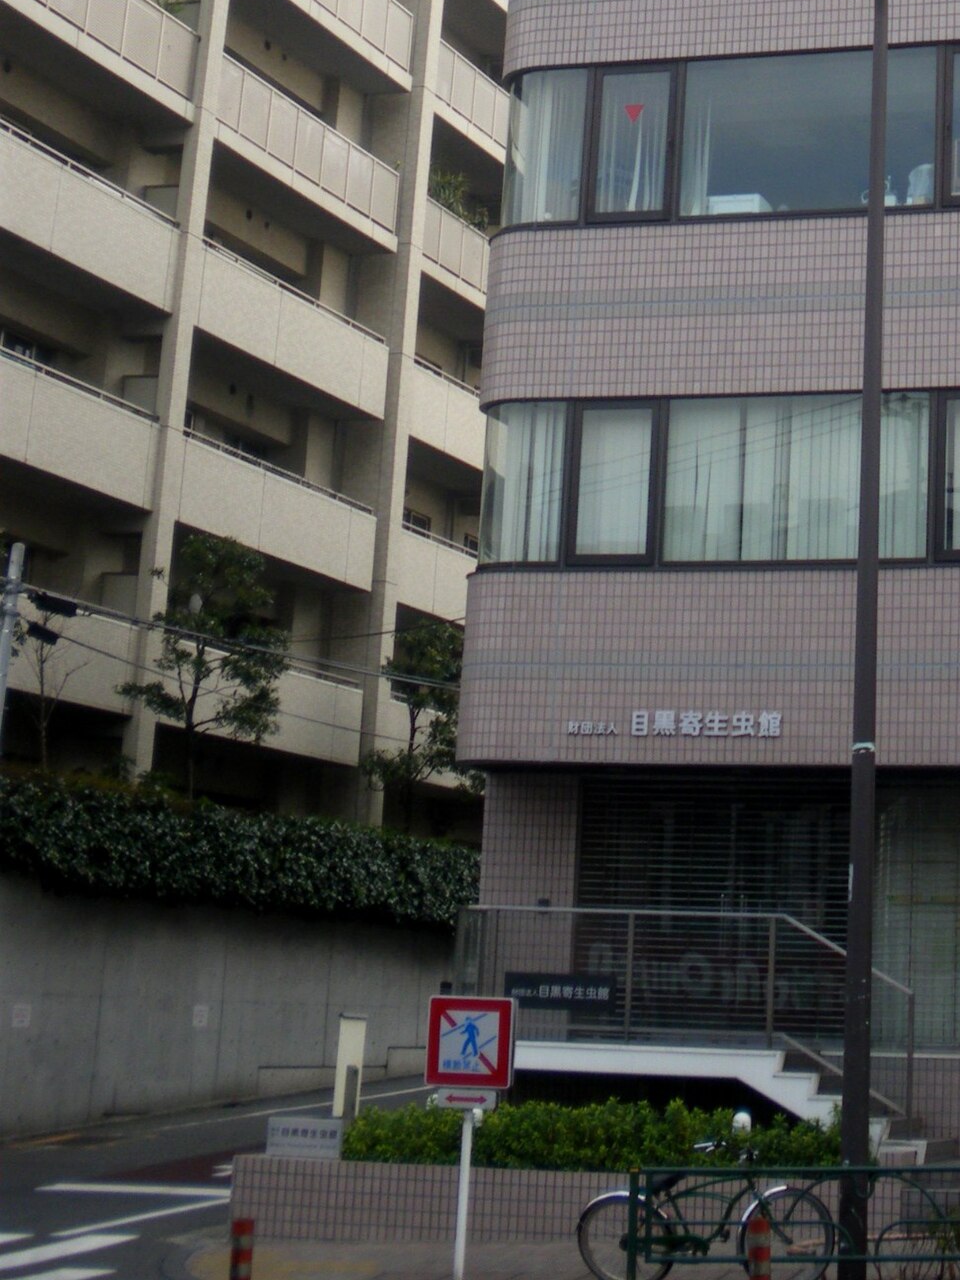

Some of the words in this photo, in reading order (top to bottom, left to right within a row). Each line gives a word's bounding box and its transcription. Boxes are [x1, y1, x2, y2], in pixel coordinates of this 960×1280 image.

[568, 721, 618, 735] 財団法人
[631, 710, 782, 737] 目黒寄生虫館
[539, 984, 610, 1001] 目黒寄生虫館
